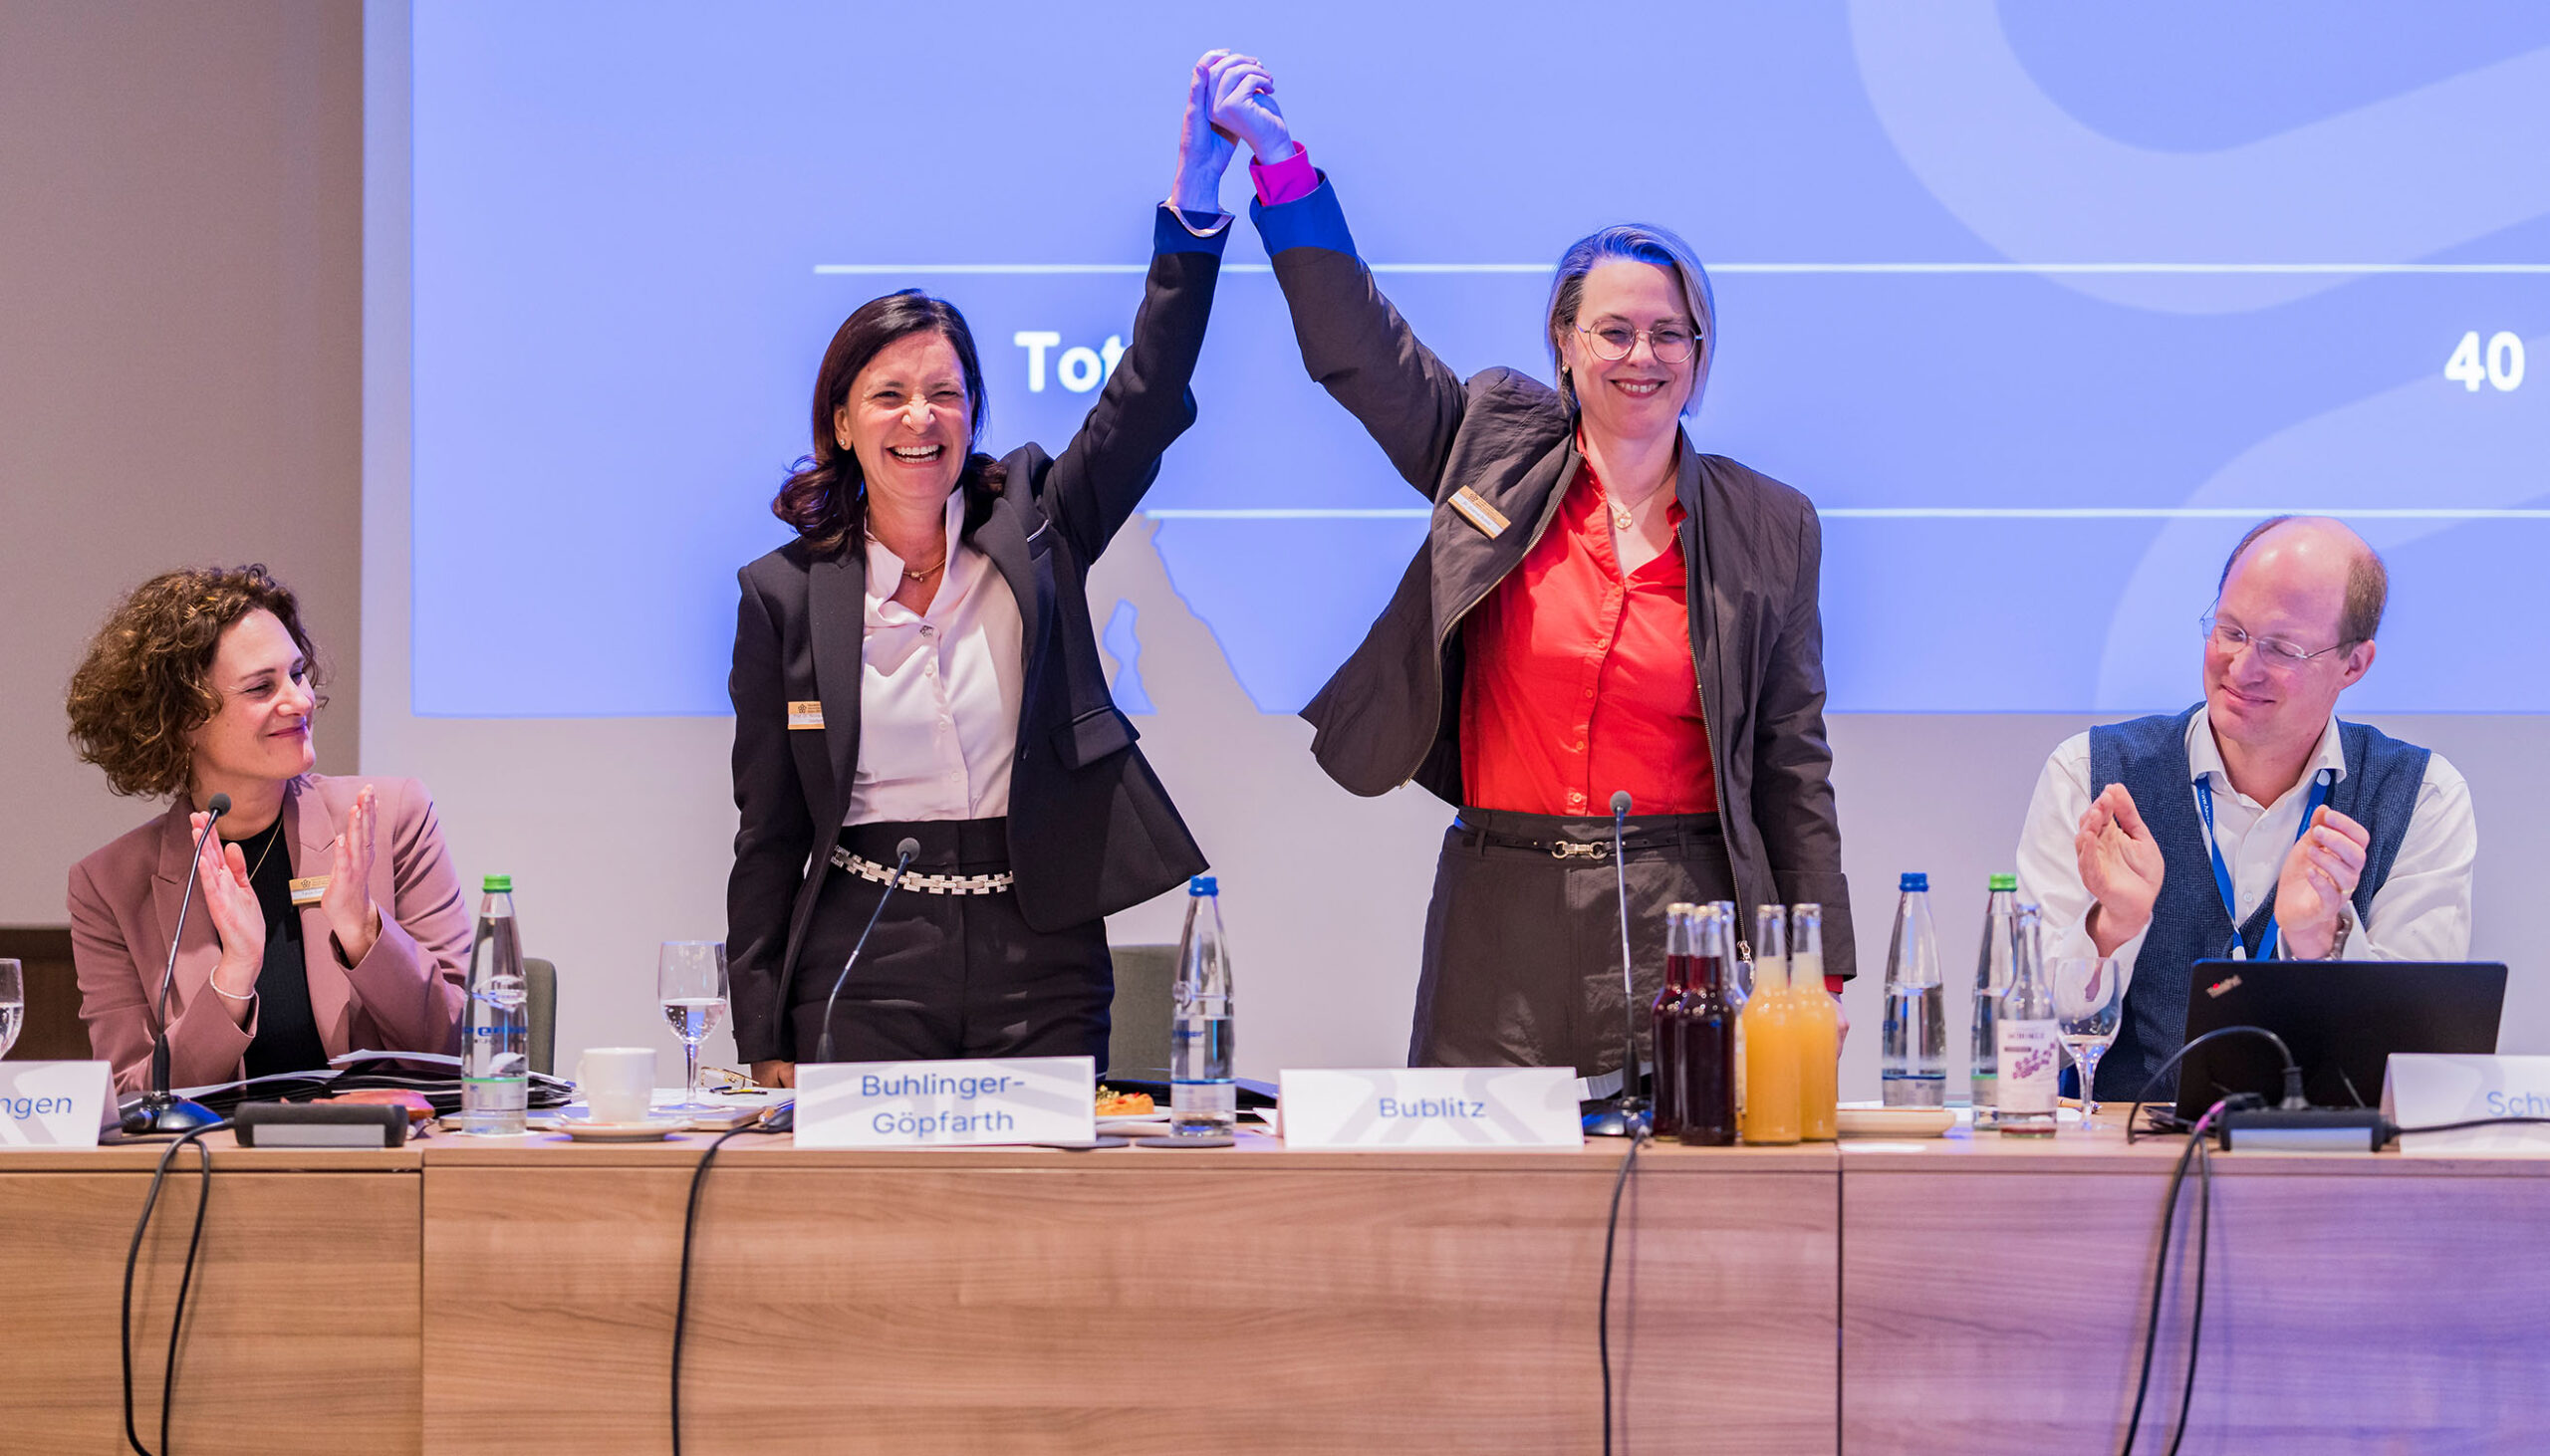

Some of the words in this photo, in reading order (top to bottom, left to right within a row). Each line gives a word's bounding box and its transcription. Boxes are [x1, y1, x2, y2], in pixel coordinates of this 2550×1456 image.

[2443, 330, 2526, 393] 40
[862, 1073, 1026, 1100] Buhlinger-
[1379, 1096, 1487, 1118] Bublitz
[873, 1110, 1014, 1138] Göpfarth
